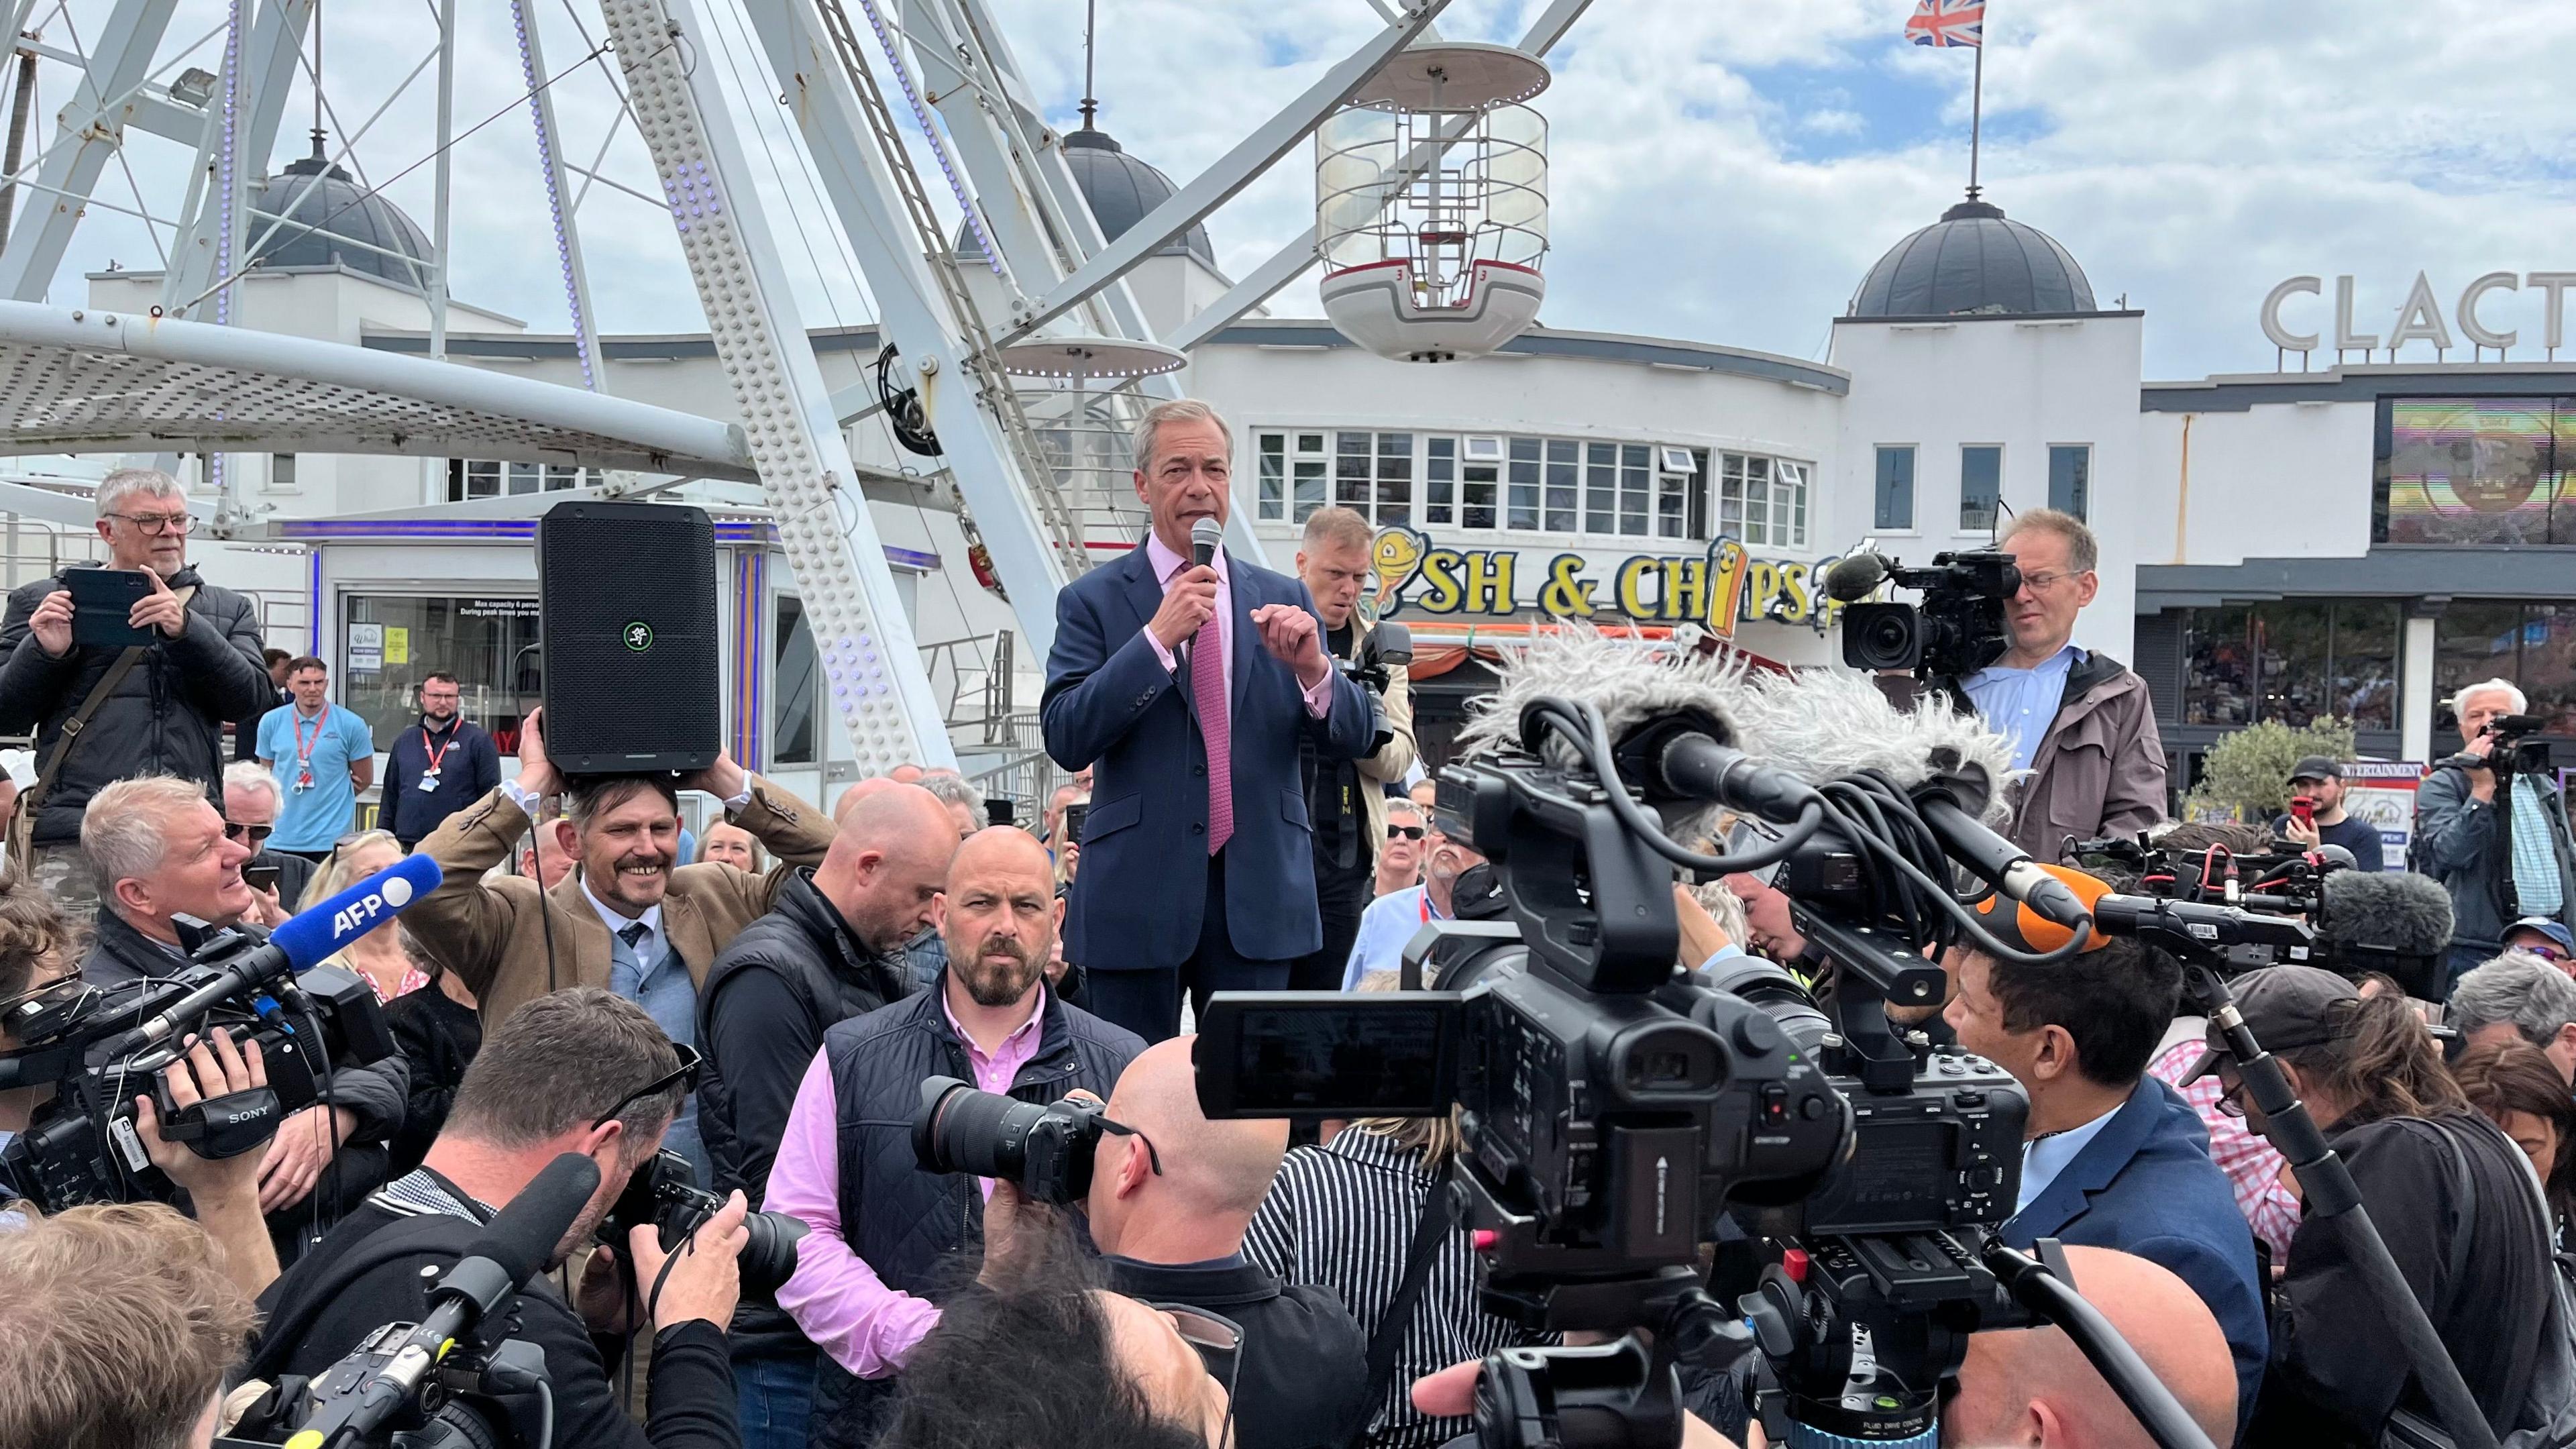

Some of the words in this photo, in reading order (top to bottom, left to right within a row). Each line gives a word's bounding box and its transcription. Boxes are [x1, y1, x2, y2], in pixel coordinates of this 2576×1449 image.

[1397, 270, 1403, 280] 3
[1480, 270, 1487, 281] 3
[2261, 270, 2576, 351] CLACT
[1540, 553, 1598, 617] &
[460, 607, 481, 616] During
[482, 608, 497, 616] peak
[488, 601, 515, 609] capacity
[2340, 763, 2422, 777] NTERTAINMENT
[334, 894, 382, 940] AFP
[229, 1105, 268, 1124] SONY
